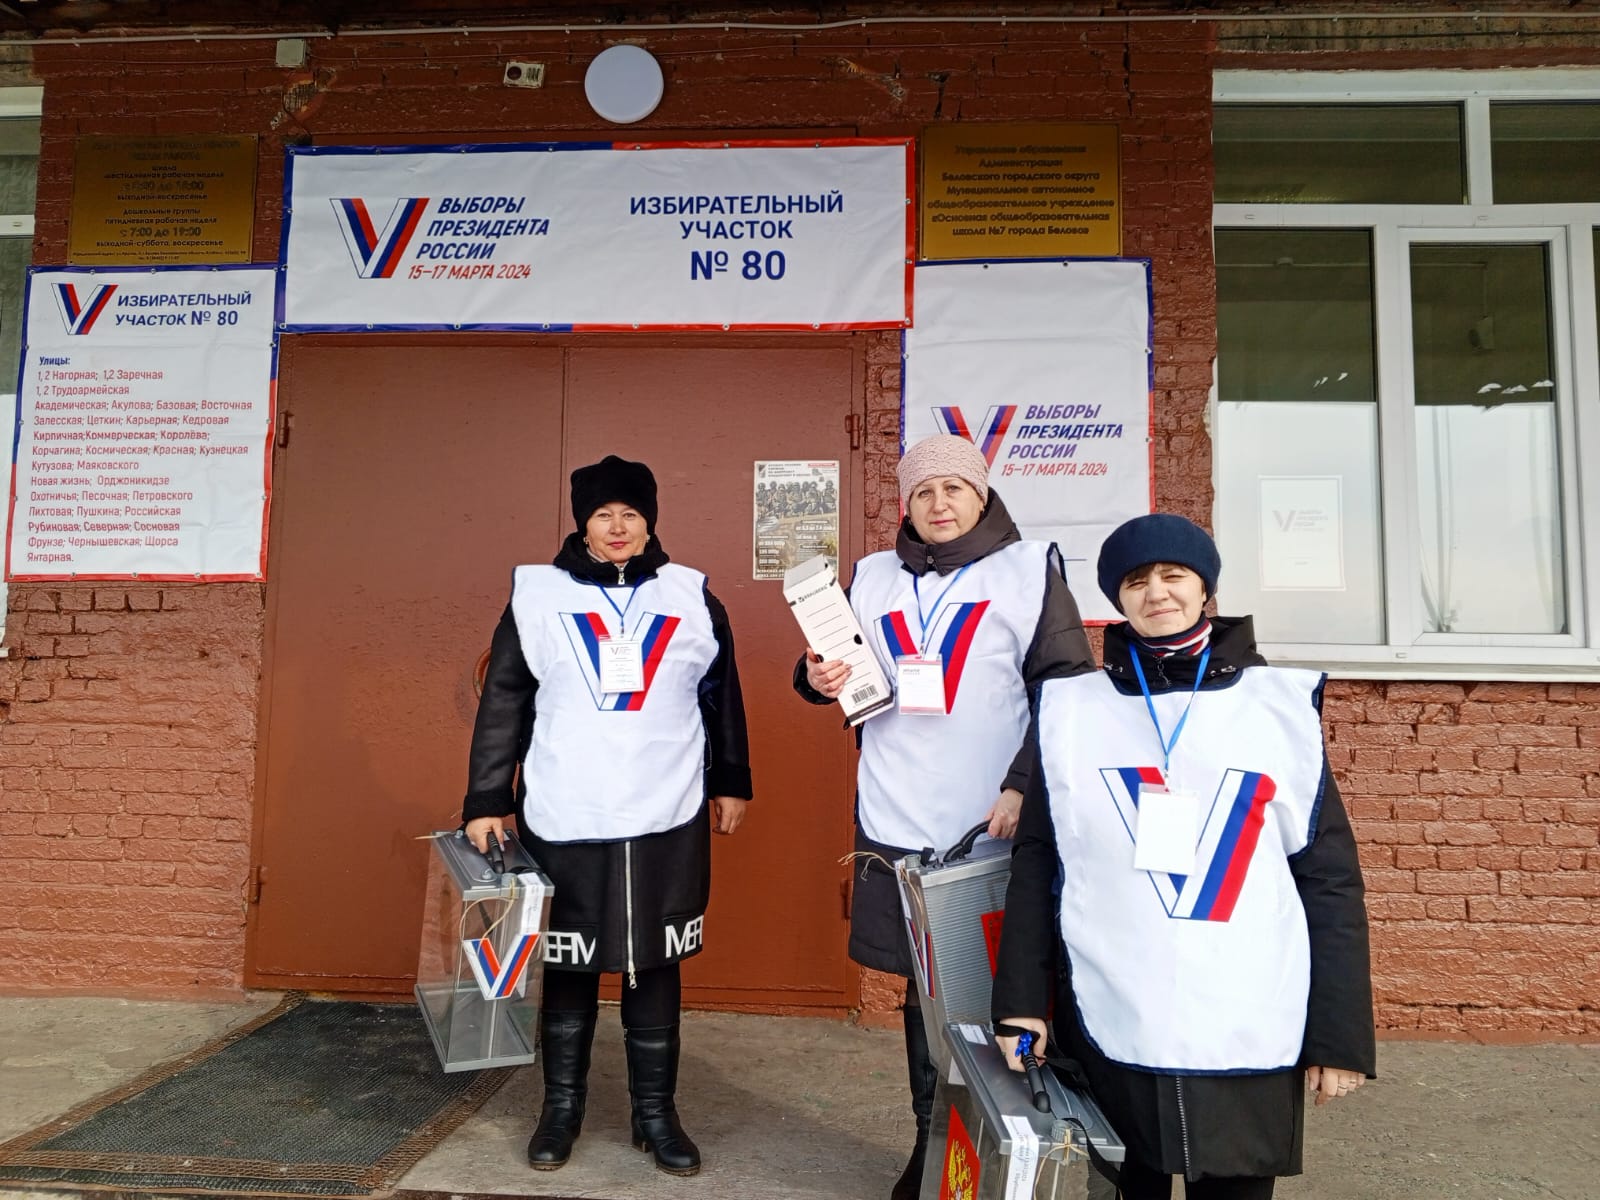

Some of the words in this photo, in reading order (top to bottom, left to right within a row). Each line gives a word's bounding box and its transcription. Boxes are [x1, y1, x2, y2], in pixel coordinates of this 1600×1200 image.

[437, 197, 527, 214] ВЫБОРЫ
[630, 190, 844, 215] ИЗБИРАТЕЛЬНЫЙ
[427, 219, 550, 239] ПРЕЗИДЕНТА
[680, 220, 793, 239] УЧАСТОК
[1008, 227, 1046, 237] города
[416, 243, 496, 259] РОССИИ
[691, 250, 729, 281] №
[741, 250, 786, 280] 80
[447, 264, 496, 280] МАРТА
[496, 264, 531, 279] 2024
[117, 291, 251, 307] ИЗБИРАТЕЛЬНЫЙ
[115, 313, 187, 327] УЧАСТОК
[191, 310, 212, 325] №
[216, 310, 239, 326] 80
[39, 356, 71, 366] Улицы:
[117, 370, 163, 381] Заречная
[52, 385, 130, 397] Трудоармейская
[201, 400, 253, 410] Восточная
[1025, 404, 1101, 420] ВЫБОРЫ
[182, 415, 230, 426] Кедровая
[1016, 424, 1124, 441] ПРЕЗИДЕНТА
[200, 445, 248, 456] Кузнецкая
[1008, 444, 1077, 459] РОССИИ
[77, 460, 139, 470] Маяковского
[1035, 463, 1077, 476] МАРТА
[1078, 463, 1108, 476] 2024
[31, 477, 58, 486] Новая
[97, 475, 170, 487] Орджоникидзе
[132, 490, 193, 502] Петровского
[125, 504, 181, 516] Российская
[134, 521, 180, 531] Сосновая
[145, 536, 178, 548] Щорса
